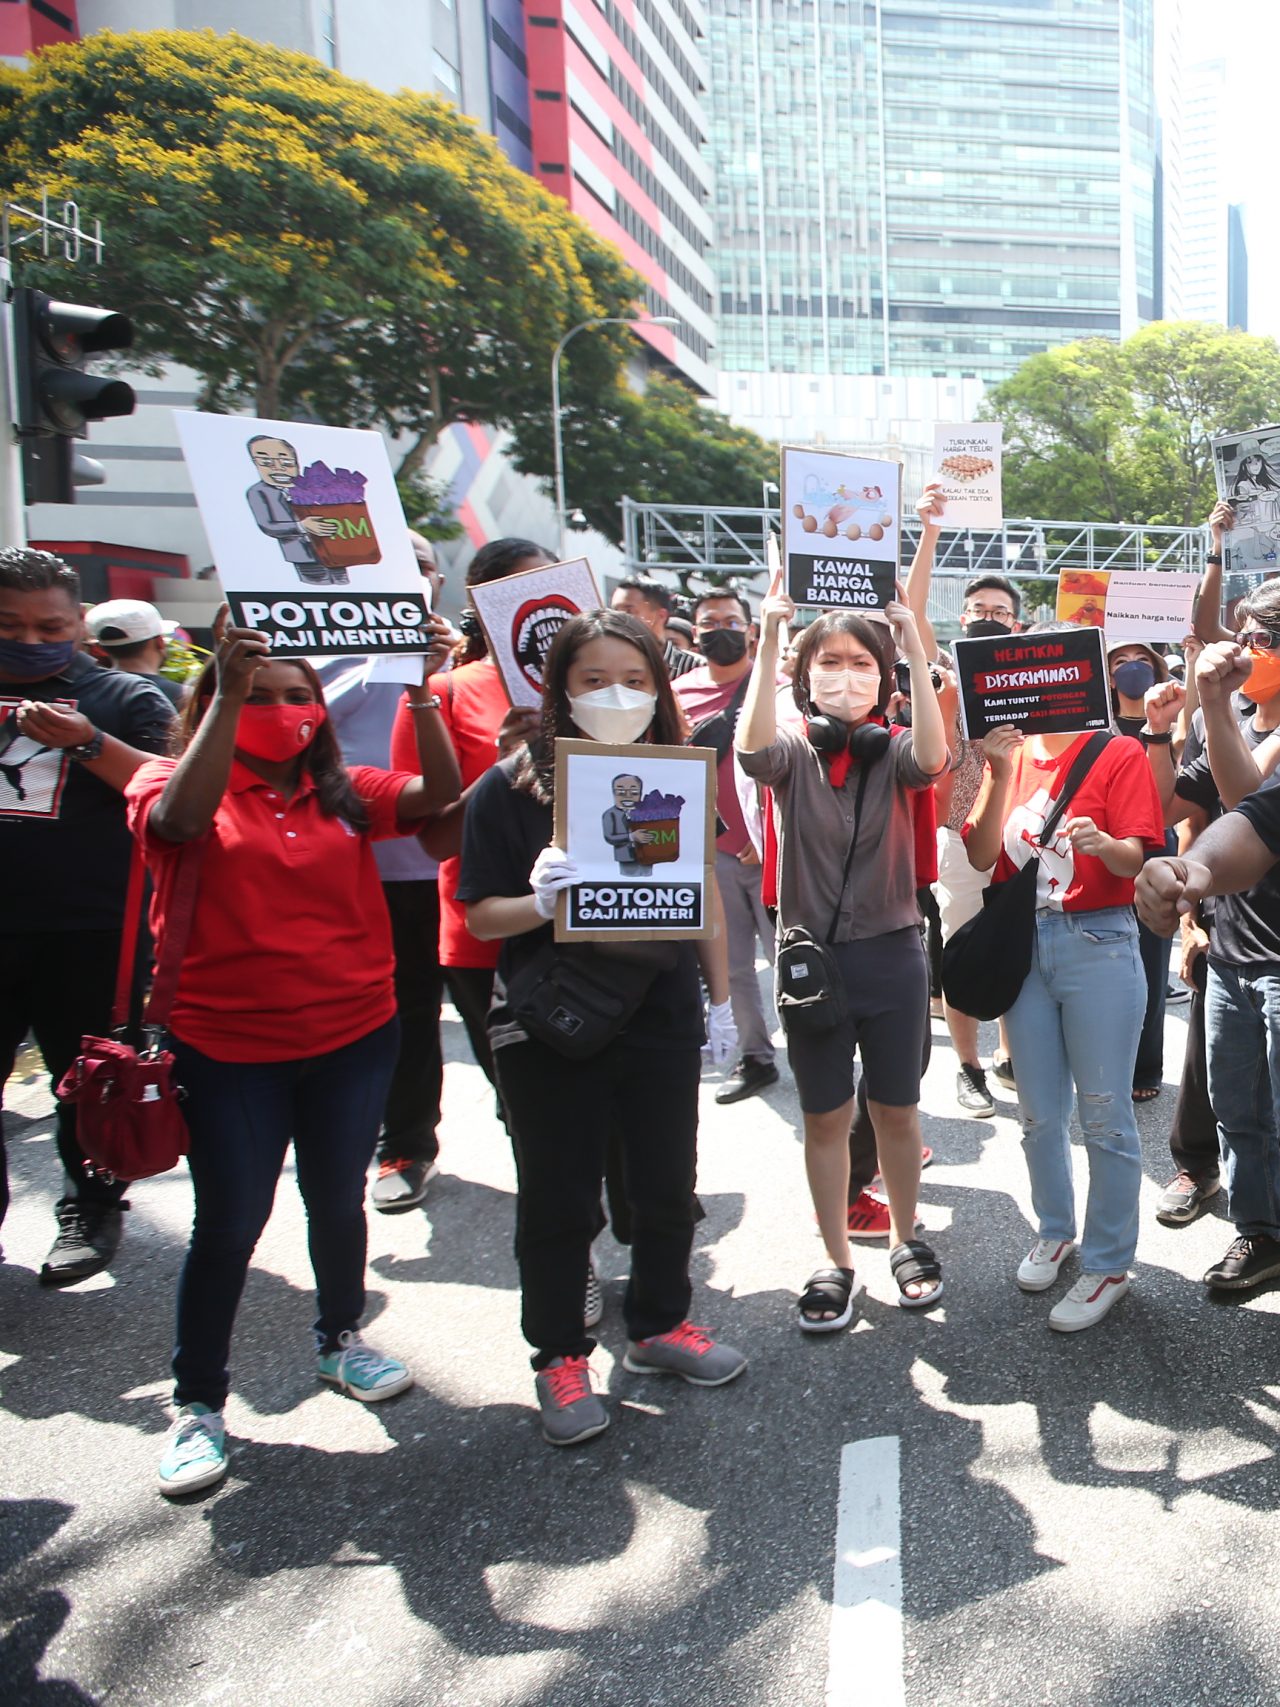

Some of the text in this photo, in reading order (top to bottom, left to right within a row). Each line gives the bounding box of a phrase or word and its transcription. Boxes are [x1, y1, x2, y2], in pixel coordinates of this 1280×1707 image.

[813, 559, 874, 577] KAWAL
[813, 574, 874, 591] HARGA
[806, 588, 879, 605] BARANG
[240, 601, 423, 628] POTONG
[1107, 611, 1140, 620] Naikkan
[1142, 613, 1164, 622] harga
[264, 628, 427, 648] GAJI MENTERI
[985, 666, 1080, 689] DISKRIMINASI
[1008, 695, 1040, 705] TUNTUT
[984, 711, 1029, 723] TERHADAP
[578, 887, 696, 907] POTONG
[578, 907, 694, 920] GAJI MENTERI
